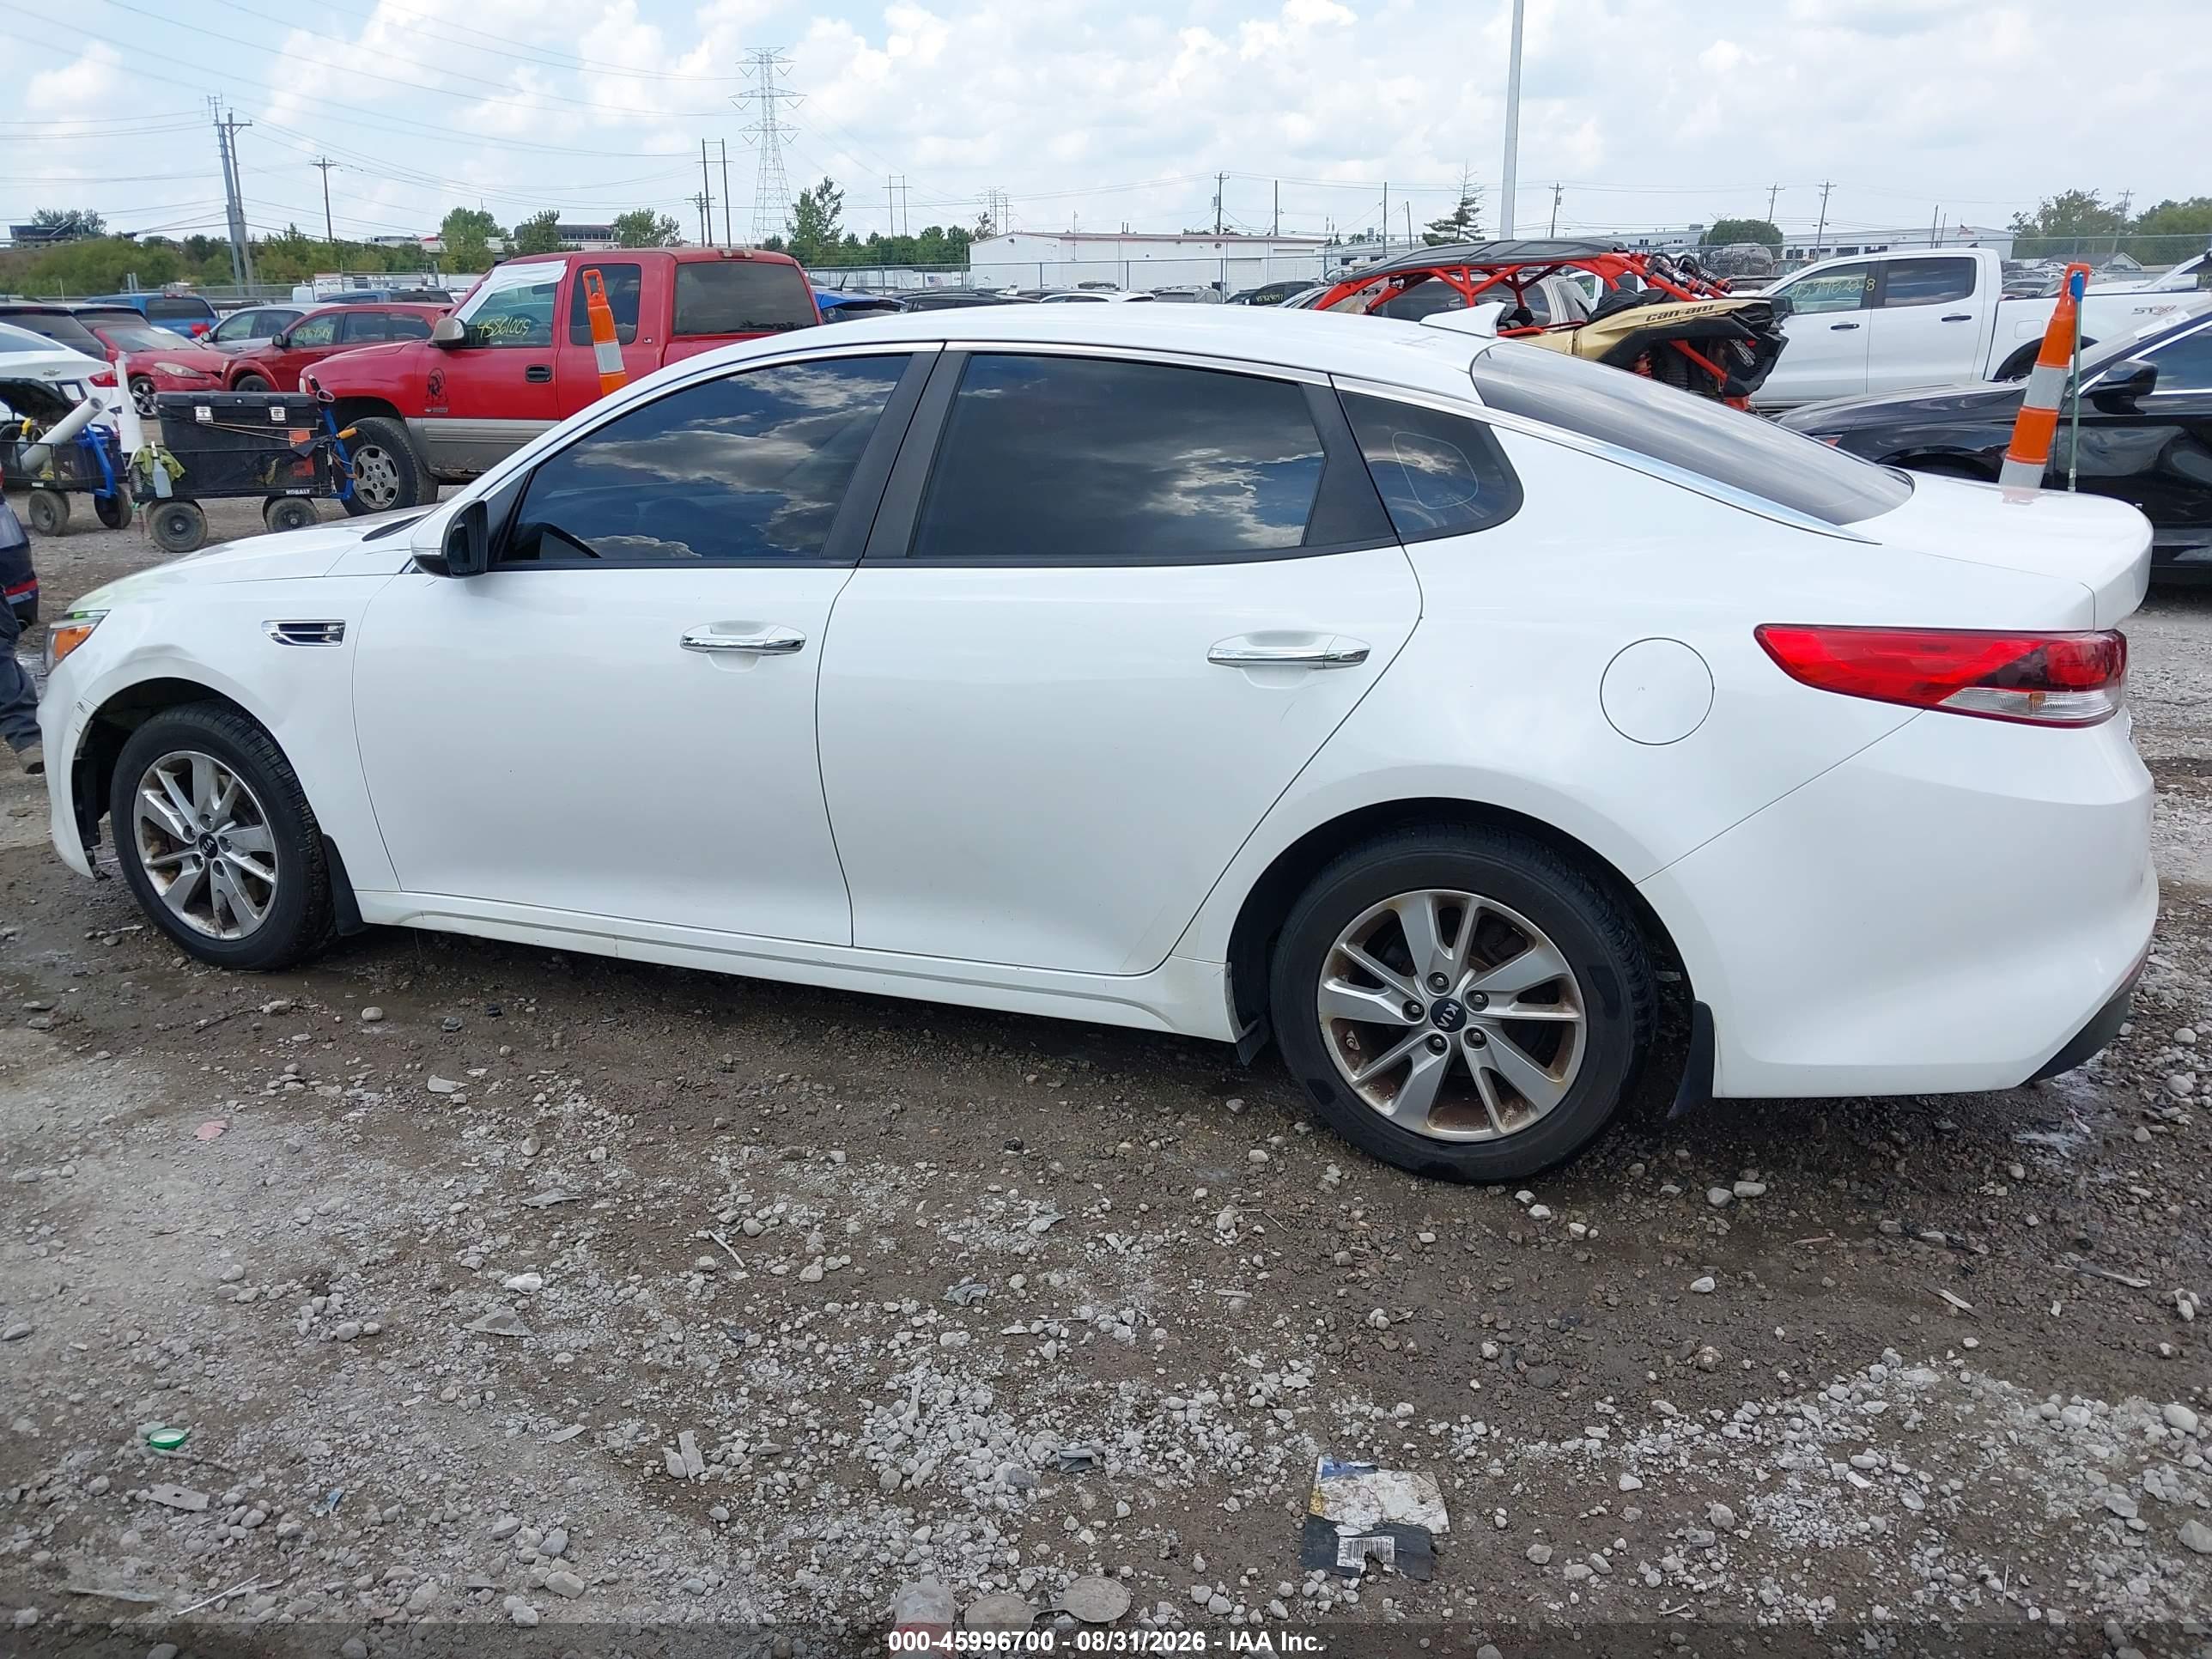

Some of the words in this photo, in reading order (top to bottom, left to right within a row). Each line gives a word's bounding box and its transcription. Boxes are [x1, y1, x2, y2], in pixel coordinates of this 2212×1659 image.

[1645, 304, 1715, 322] can-am
[200, 838, 216, 855] KIA
[1437, 1002, 1460, 1028] KIA
